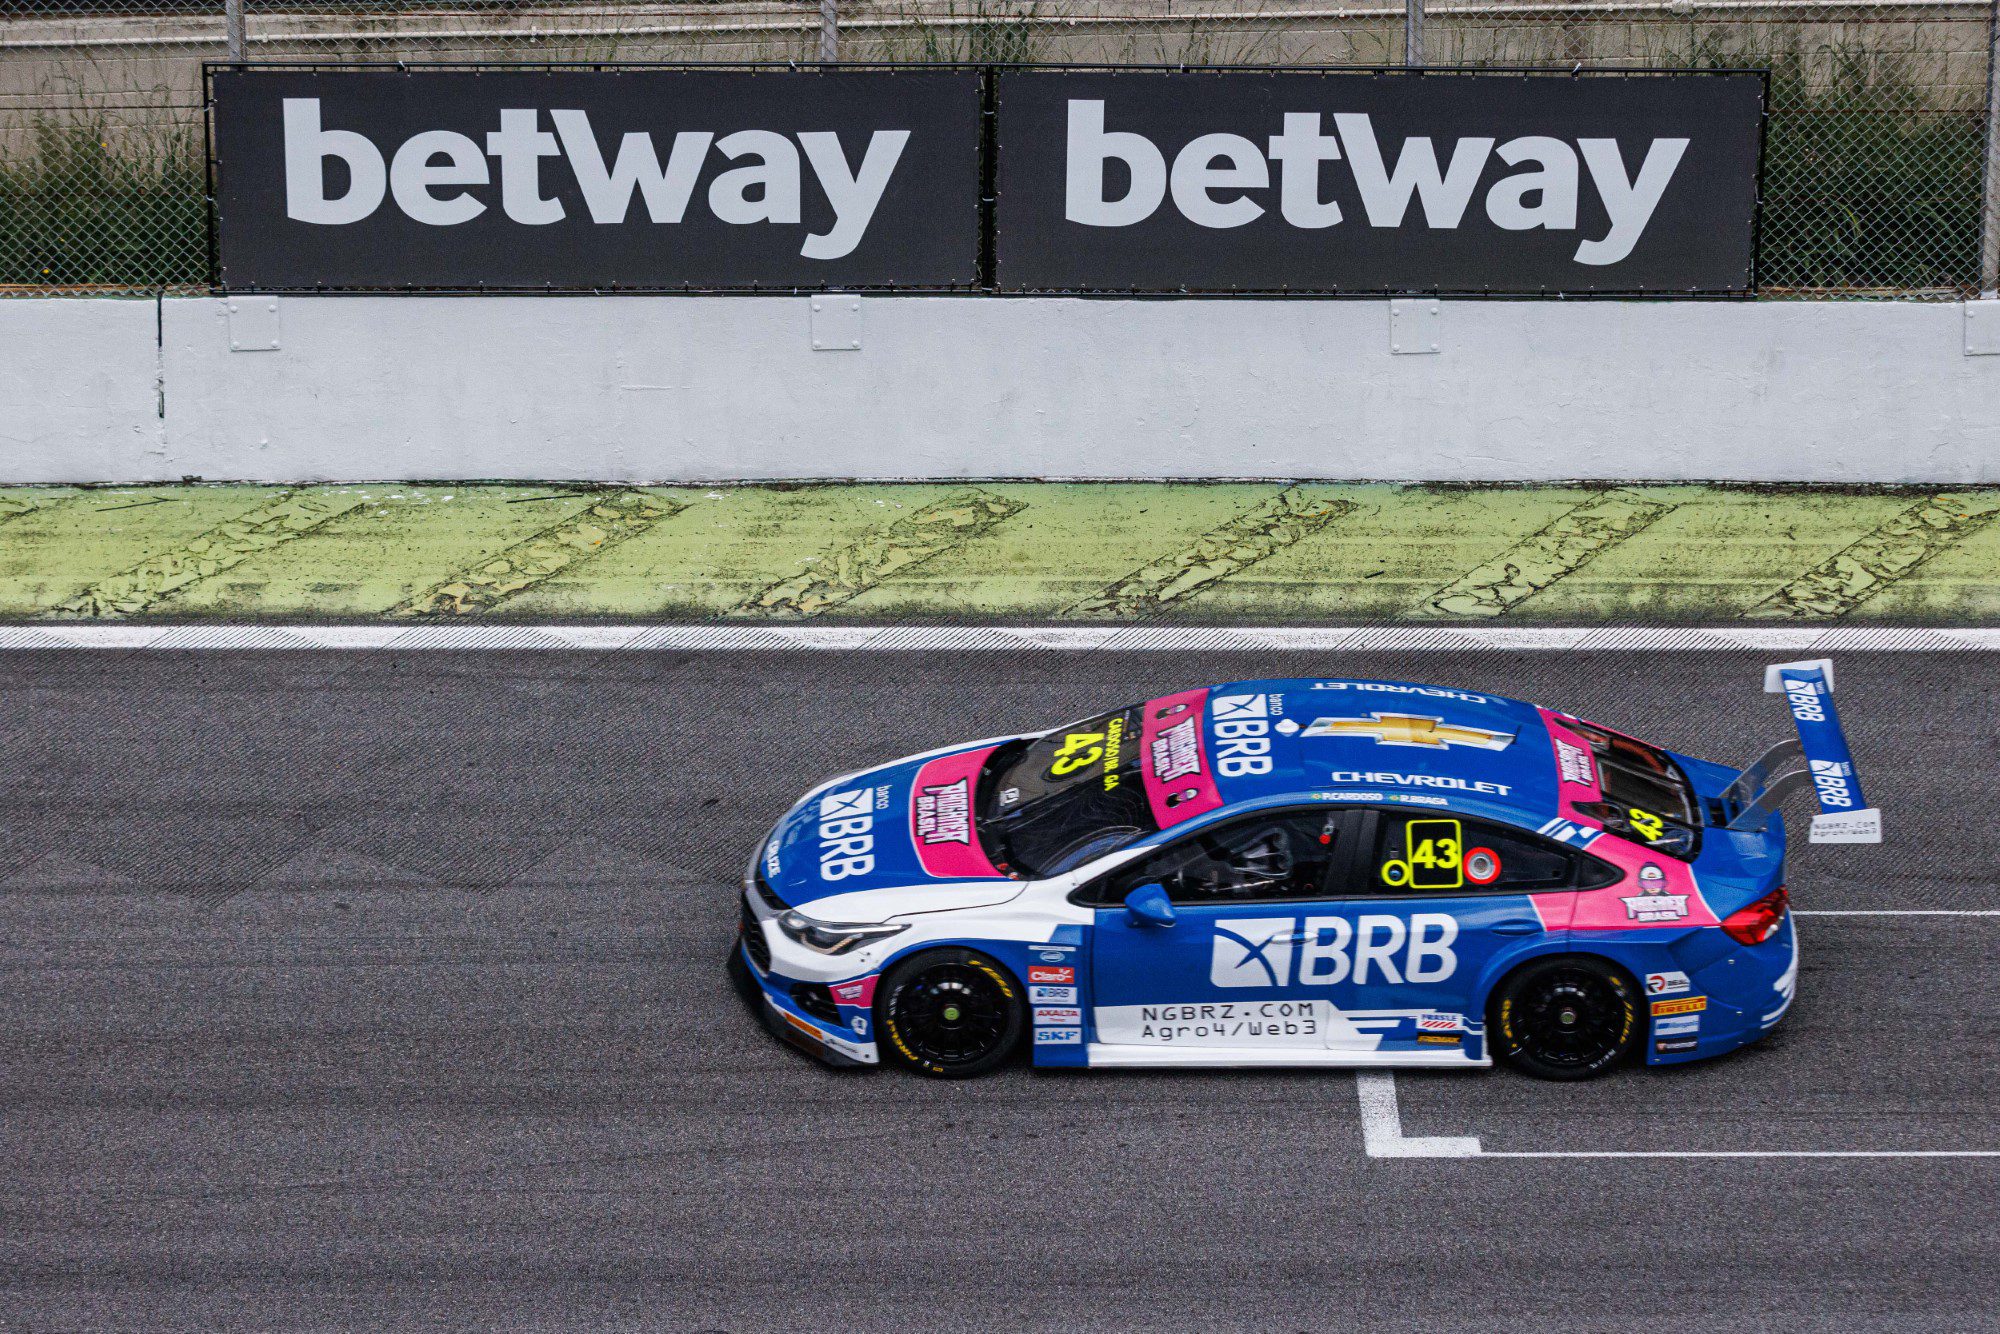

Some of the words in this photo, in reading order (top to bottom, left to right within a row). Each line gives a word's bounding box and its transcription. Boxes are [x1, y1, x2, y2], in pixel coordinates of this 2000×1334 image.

[283, 97, 911, 260] betway
[1065, 99, 1690, 265] betway
[1269, 693, 1285, 716] banco
[1310, 682, 1486, 704] CHEVROLET
[1789, 694, 1825, 722] BRB
[1051, 732, 1105, 775] 43
[1214, 720, 1274, 778] BRB
[876, 784, 893, 810] banco
[1331, 771, 1512, 796] CHEVROLET
[1814, 776, 1853, 806] BRB
[916, 796, 936, 837] BRASIL
[1629, 808, 1663, 841] 43
[818, 815, 875, 882] BRB
[1412, 838, 1459, 869] 43
[1299, 913, 1459, 986] BRB
[1030, 970, 1067, 981] Claro
[1048, 988, 1070, 998] BRB
[1651, 997, 1706, 1015] PIRELLI
[1036, 1009, 1079, 1017] AXALTA
[1142, 1002, 1314, 1021] NGBRZ.COM
[1037, 1031, 1079, 1041] SKF
[1141, 1020, 1317, 1041] Agro4/Web3
